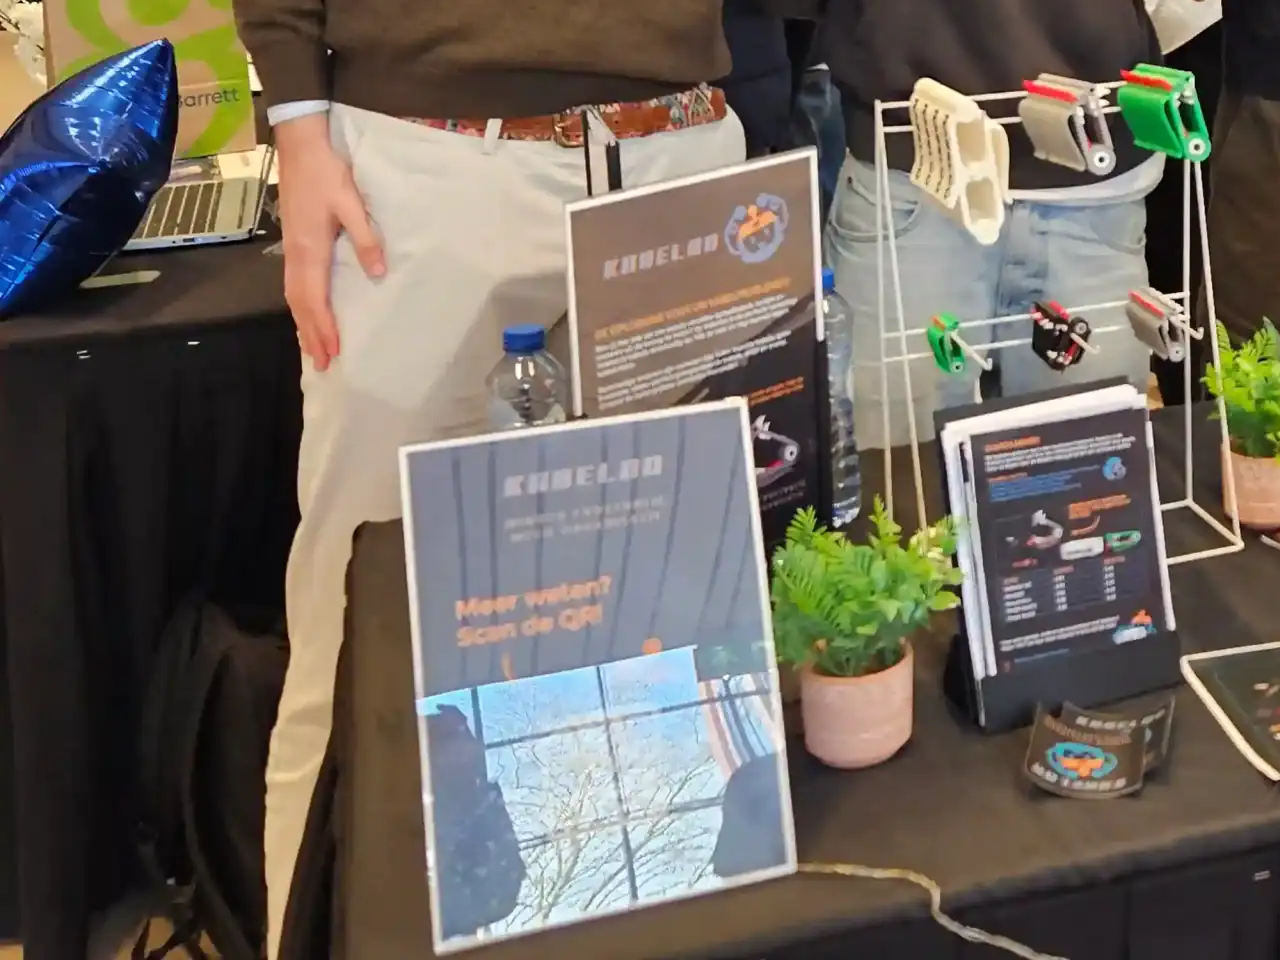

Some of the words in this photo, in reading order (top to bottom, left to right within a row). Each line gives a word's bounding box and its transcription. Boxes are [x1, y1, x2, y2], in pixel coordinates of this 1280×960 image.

[178, 87, 242, 108] arrett
[456, 594, 518, 621] Meer
[523, 575, 612, 611] weten?
[456, 622, 518, 648] Scan
[520, 615, 554, 637] de
